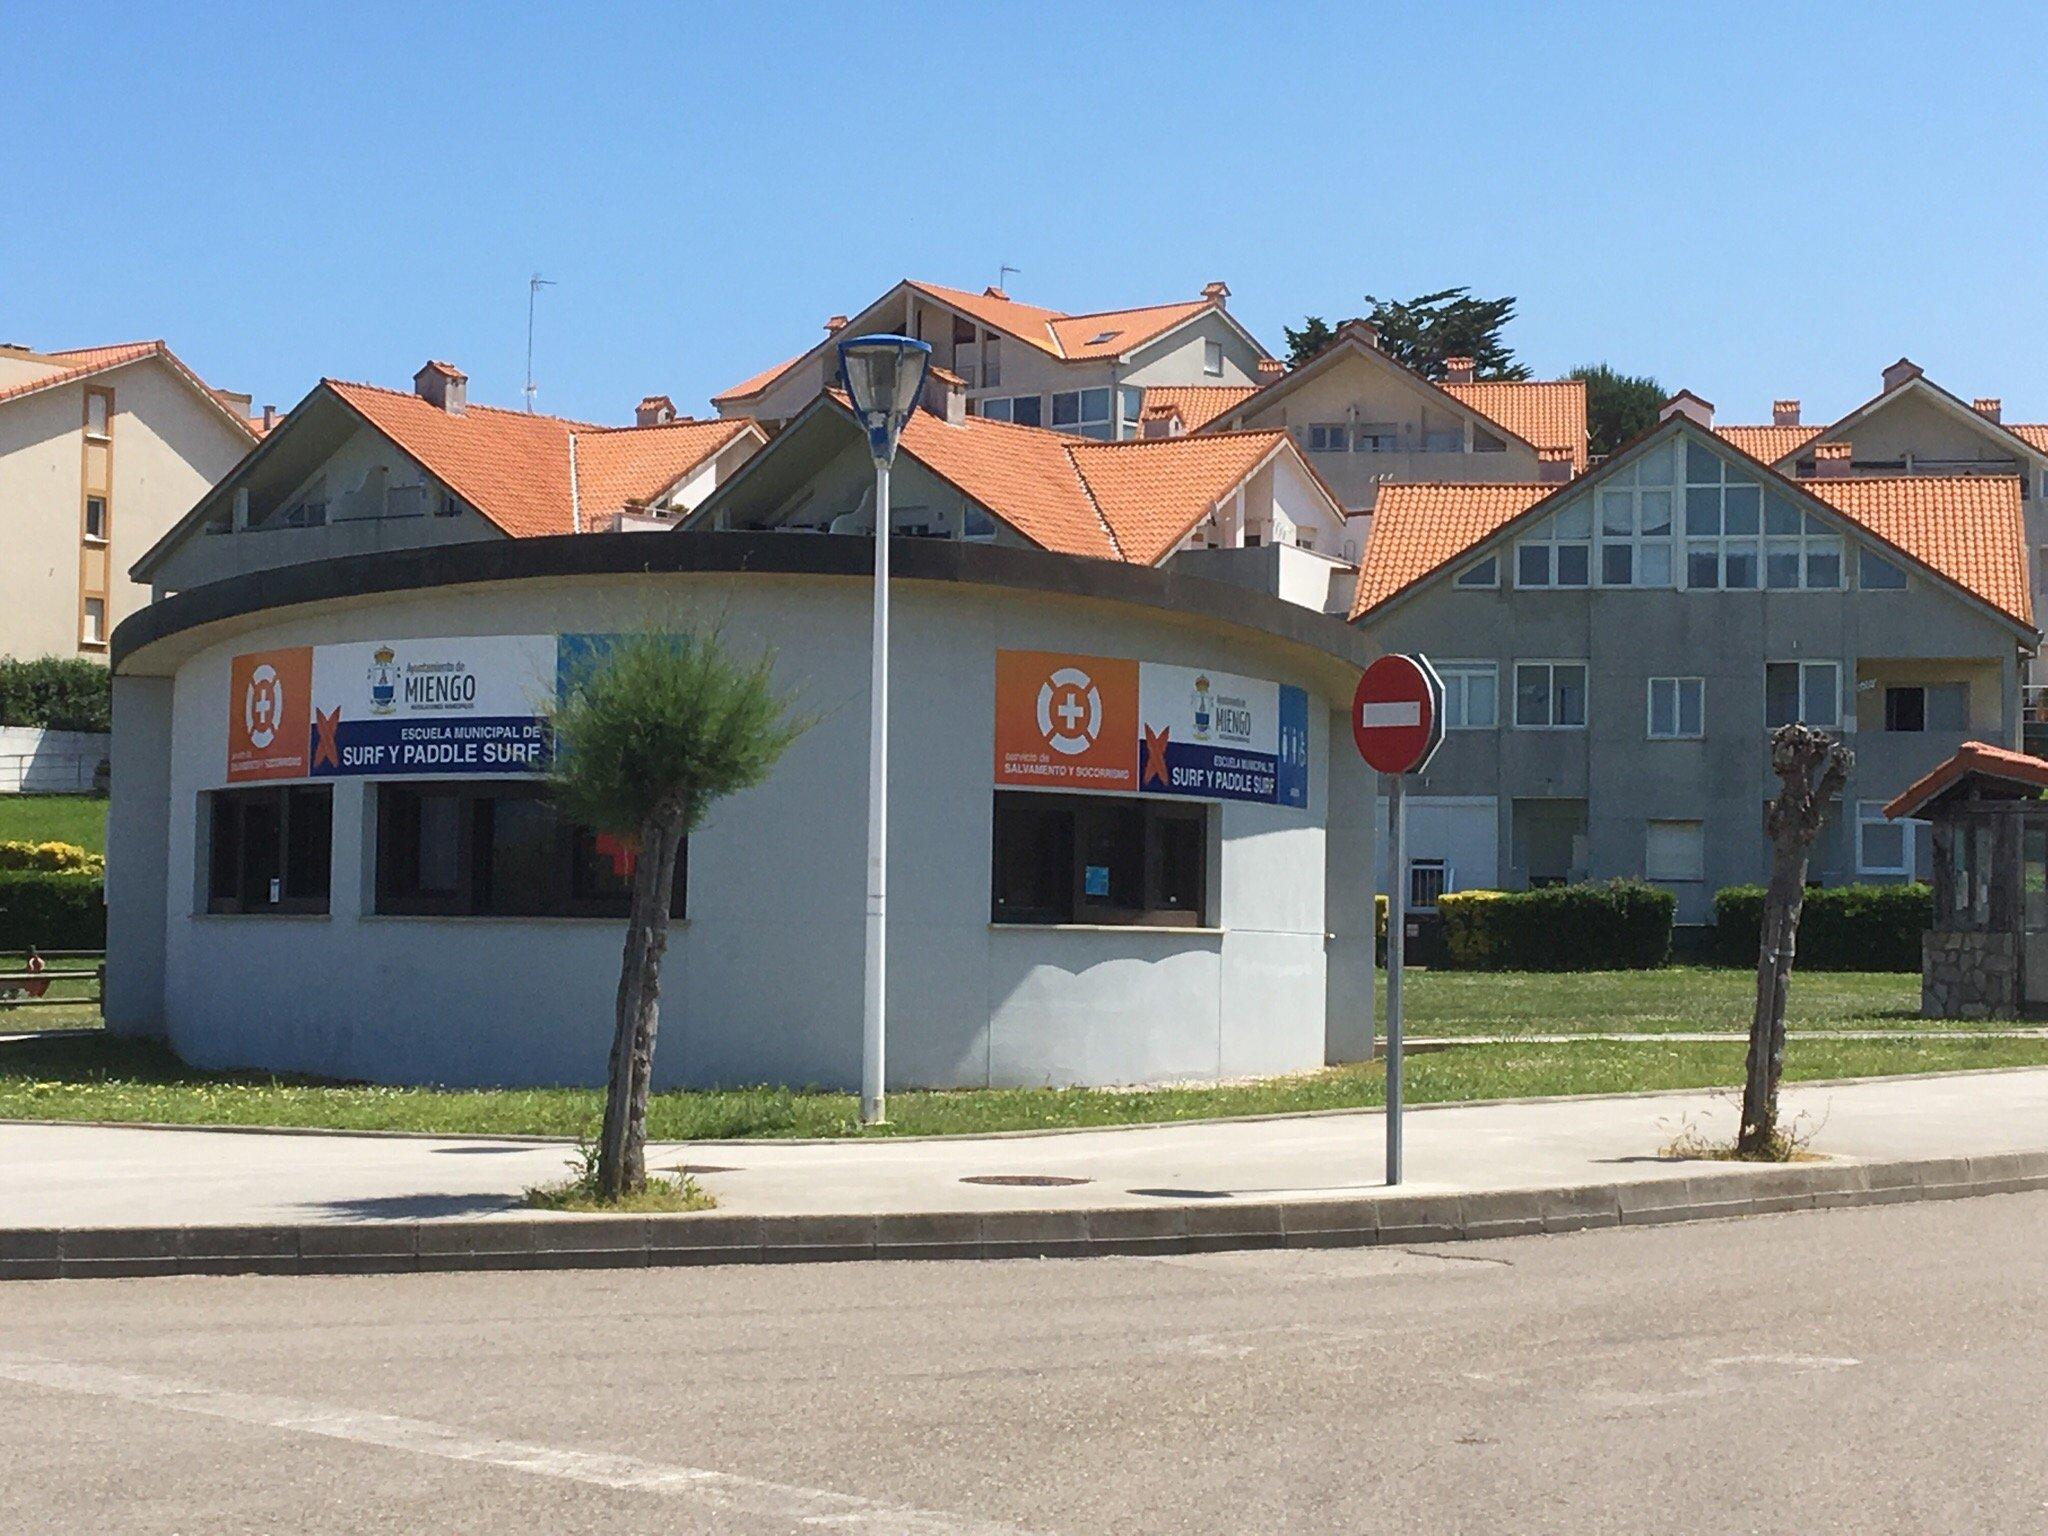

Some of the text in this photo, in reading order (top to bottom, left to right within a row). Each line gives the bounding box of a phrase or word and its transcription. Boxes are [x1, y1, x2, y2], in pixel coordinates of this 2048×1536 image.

[405, 675, 476, 703] MIENGO
[401, 725, 541, 742] ESCUELA MUNICIPAL DE
[1216, 707, 1251, 736] MIENGO
[342, 742, 541, 767] SURF Y PADDLE SURF
[1213, 755, 1241, 769] ESCUELA
[1004, 763, 1067, 777] SALVAMENTO
[1066, 767, 1073, 776] Y
[1172, 766, 1205, 788] SURF
[1206, 770, 1214, 788] Y
[1215, 771, 1252, 793] PADDLE
[1253, 775, 1276, 794] SURF
